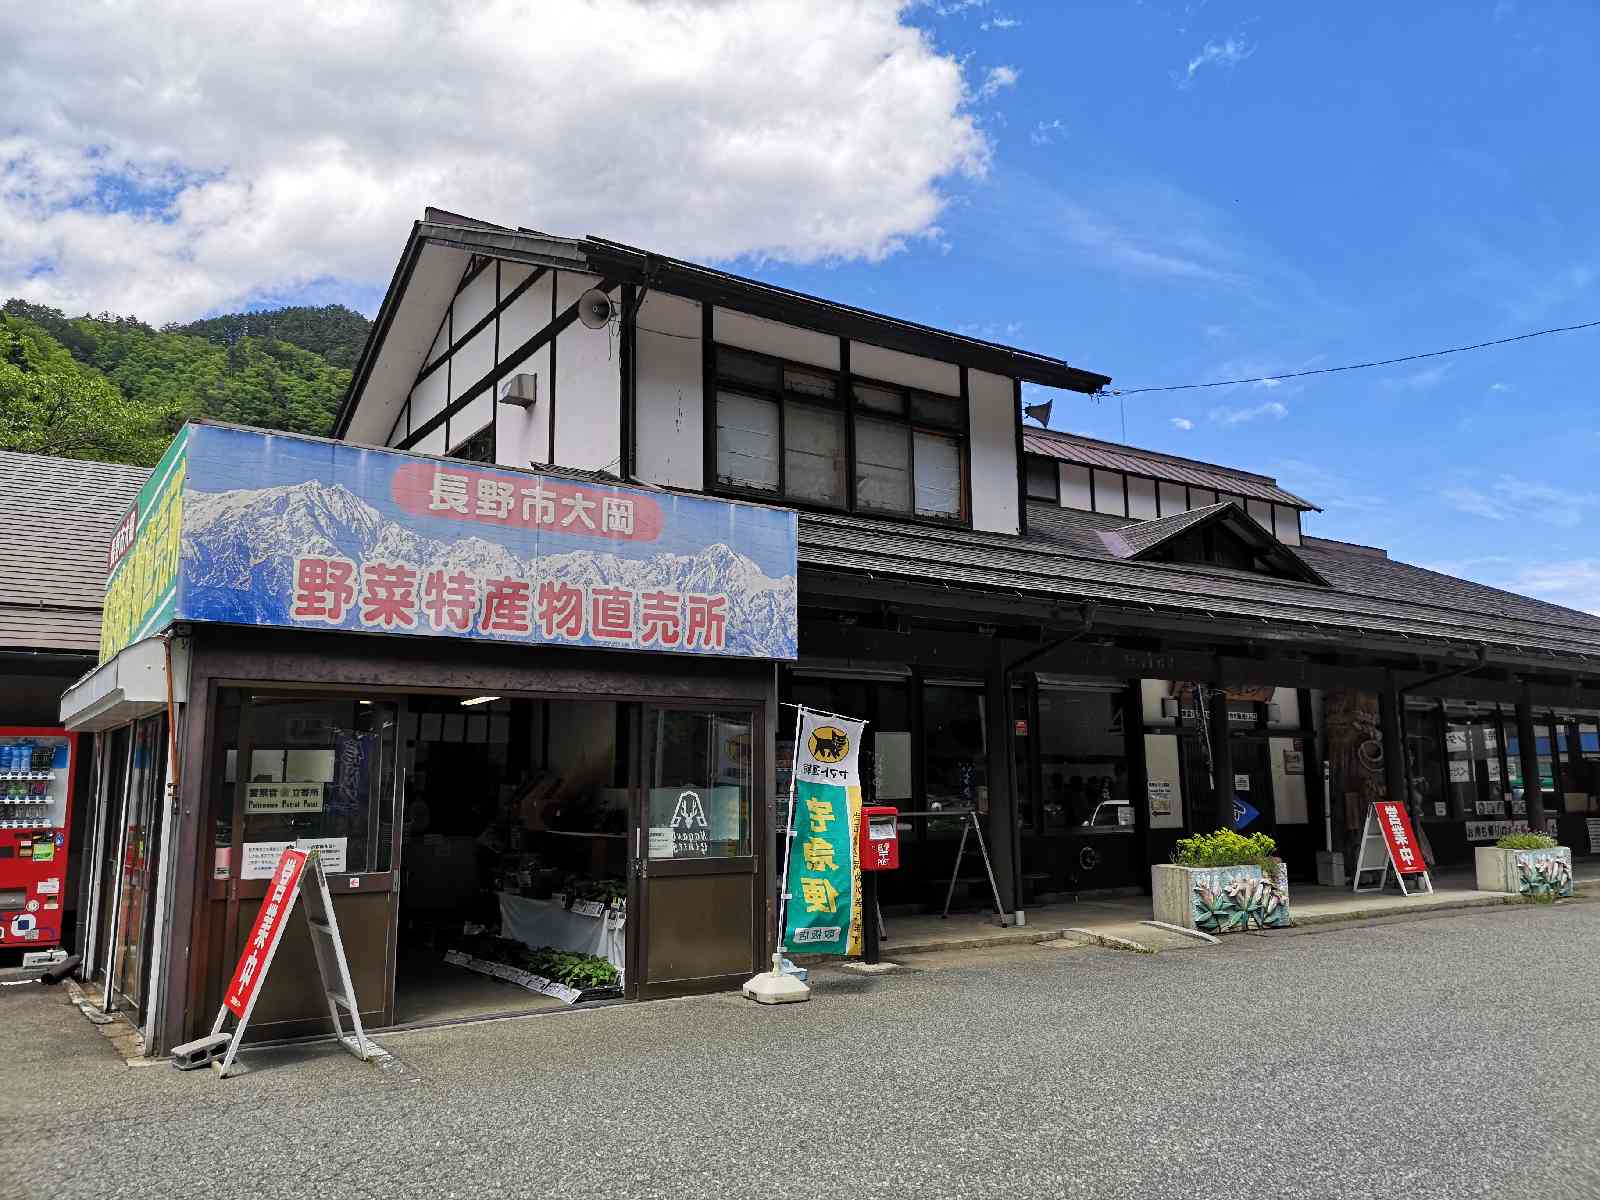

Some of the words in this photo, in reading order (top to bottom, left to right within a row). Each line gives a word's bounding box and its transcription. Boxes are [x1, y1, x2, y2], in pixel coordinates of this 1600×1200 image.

[428, 471, 635, 535] 長野市大岡
[291, 556, 727, 650] 野菜特産物直売所
